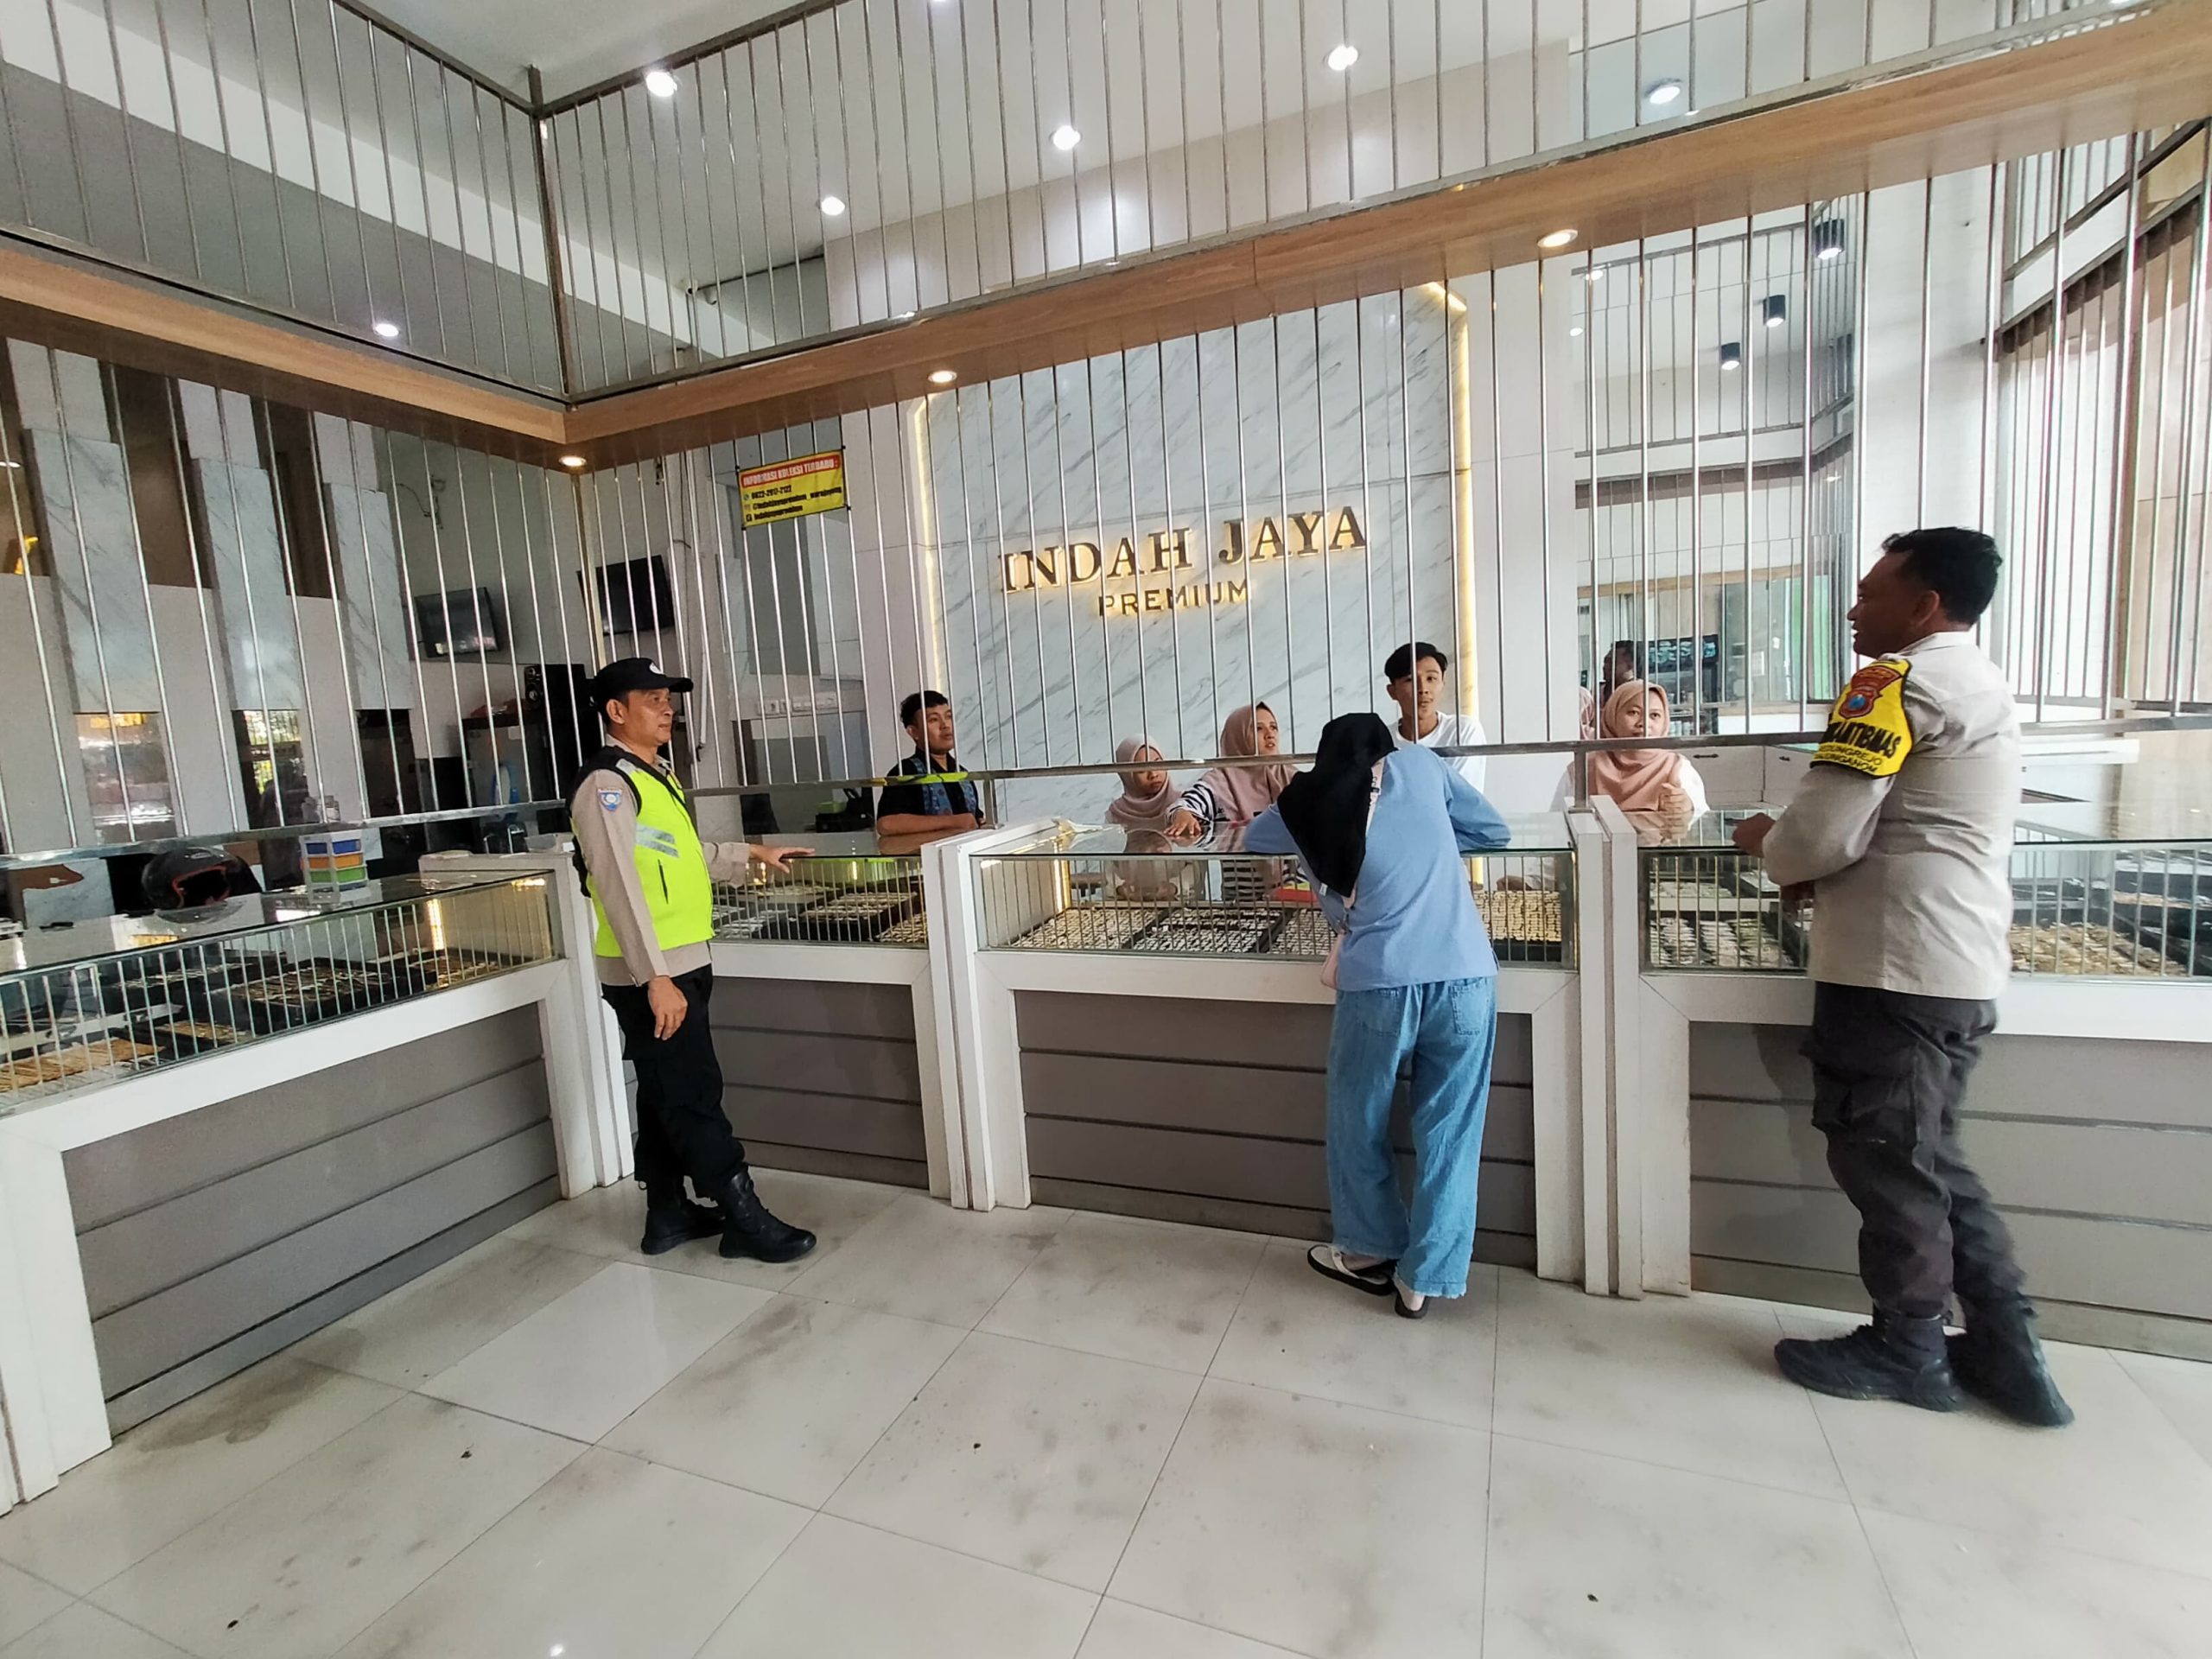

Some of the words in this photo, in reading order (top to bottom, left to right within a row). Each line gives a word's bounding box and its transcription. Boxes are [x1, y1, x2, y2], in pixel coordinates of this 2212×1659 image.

[998, 527, 1196, 593] INDAH
[1218, 506, 1368, 563] JAYA
[1098, 579, 1249, 616] PREMIUM
